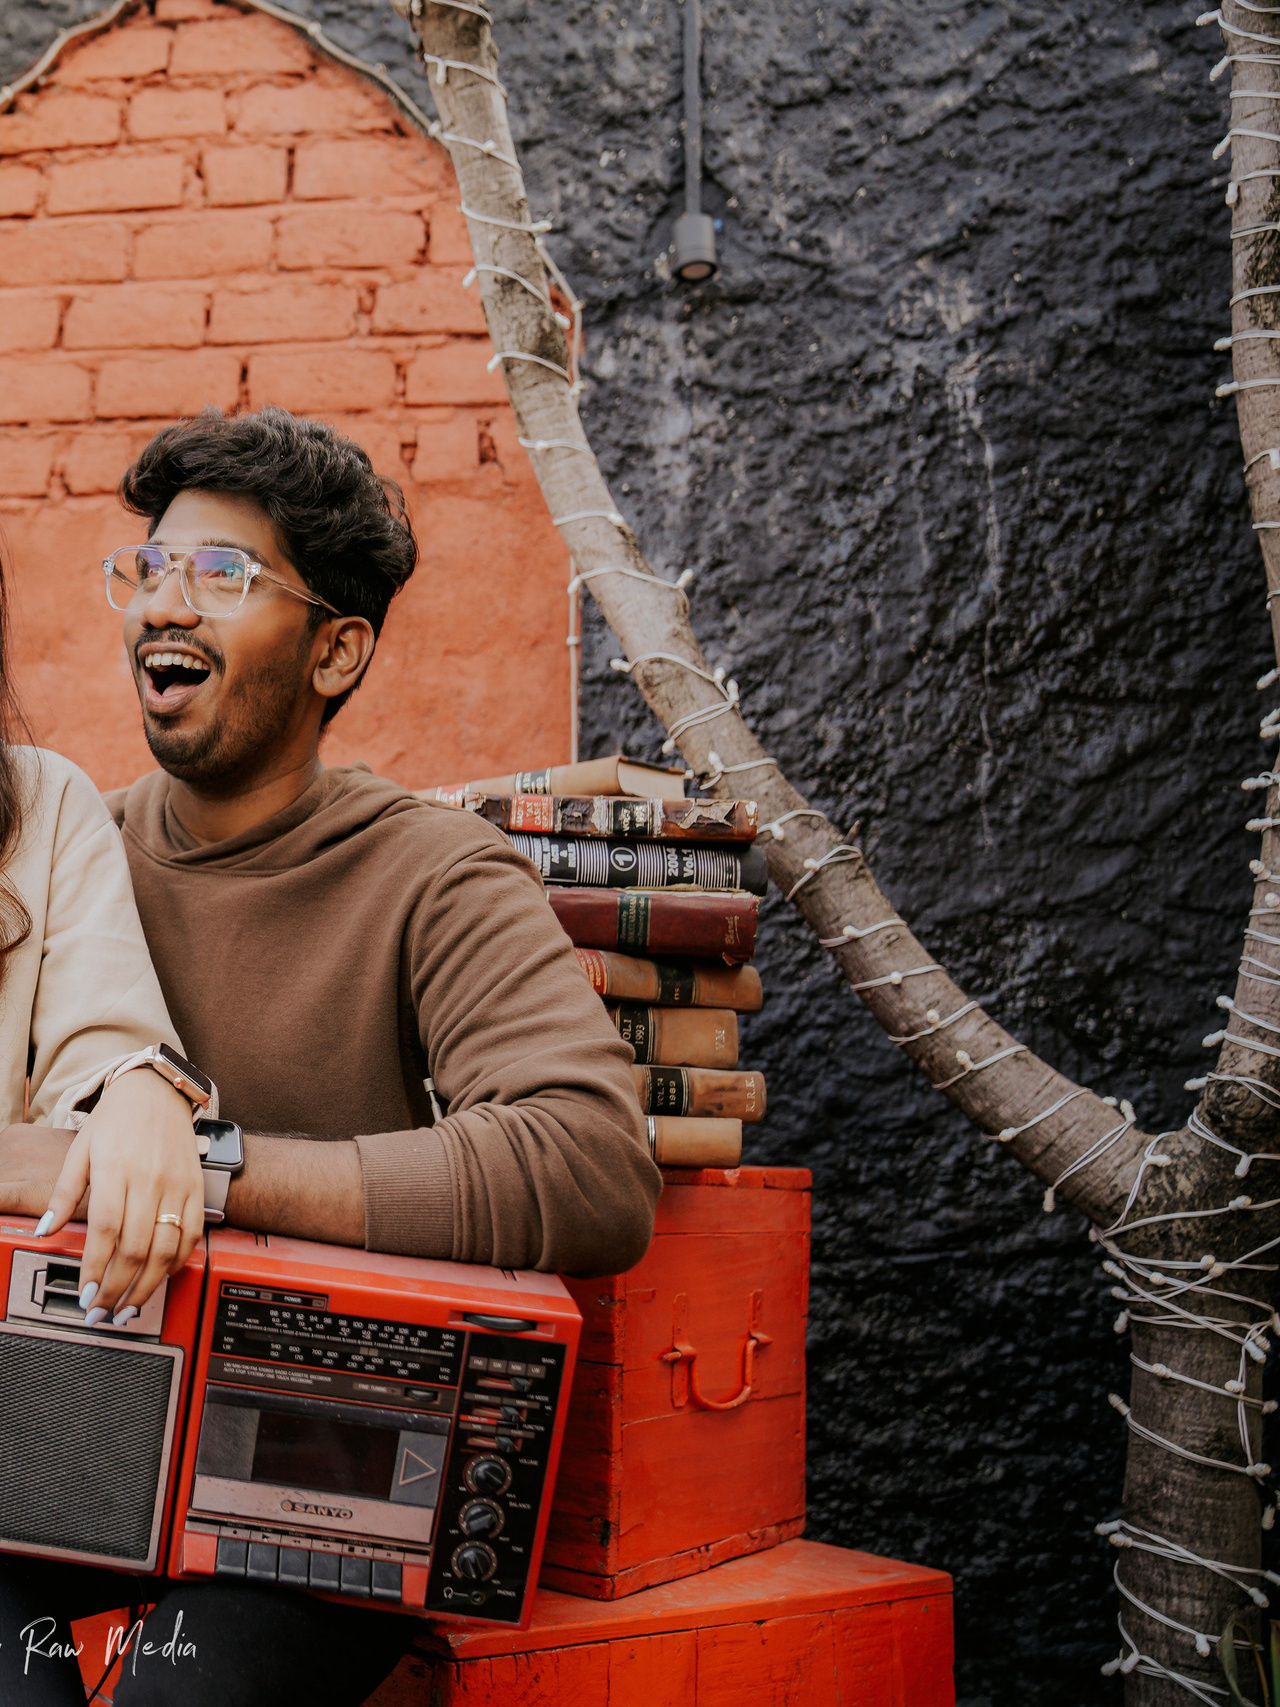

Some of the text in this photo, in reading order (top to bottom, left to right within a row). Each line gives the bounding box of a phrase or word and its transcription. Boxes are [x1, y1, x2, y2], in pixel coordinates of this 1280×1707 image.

[567, 843, 576, 868] RULES
[666, 847, 679, 877] 2004
[682, 849, 694, 877] Vol.1
[635, 1024, 645, 1045] 1993
[284, 1295, 302, 1303] POWER
[353, 1321, 363, 1329] 100
[368, 1323, 378, 1331] 102
[384, 1325, 394, 1333] 104
[370, 1384, 387, 1392] TUNING
[519, 1458, 539, 1466] VOLUME
[293, 1503, 351, 1519] SANYO
